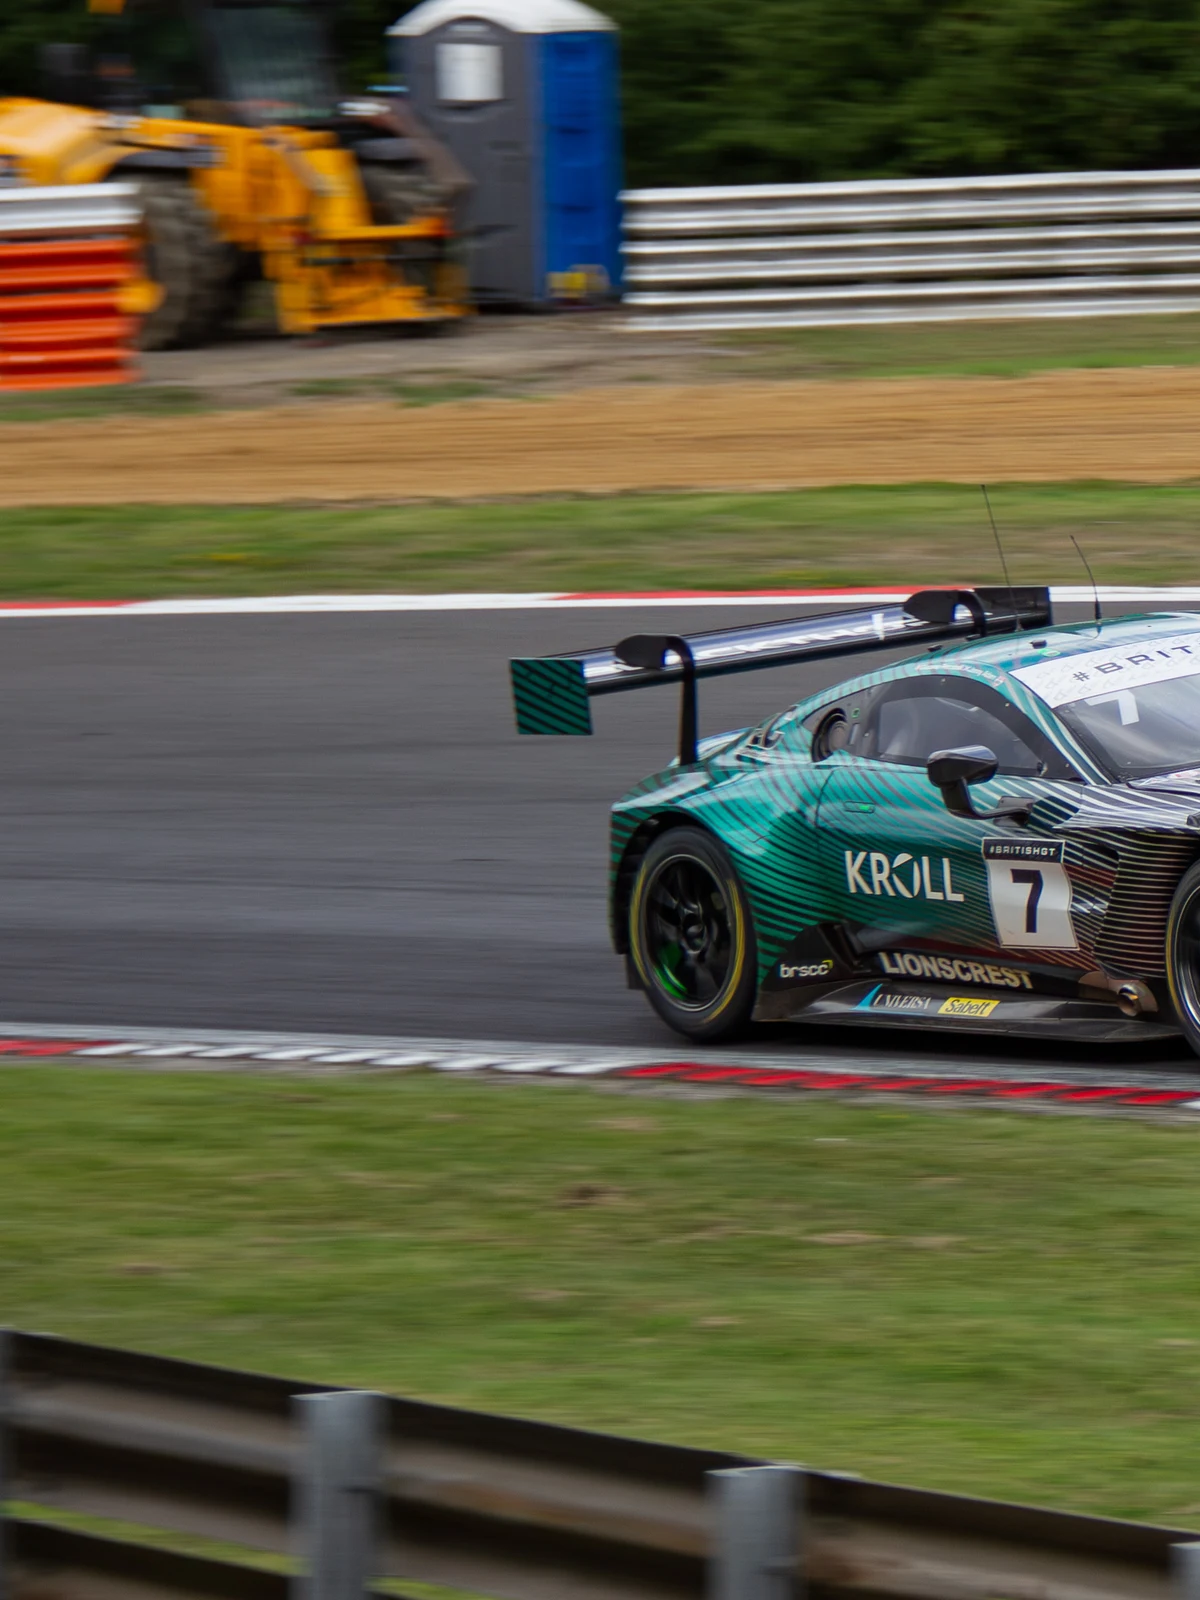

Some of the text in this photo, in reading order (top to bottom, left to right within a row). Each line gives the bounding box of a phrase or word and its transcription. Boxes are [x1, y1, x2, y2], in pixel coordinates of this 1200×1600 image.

[1085, 689, 1139, 725] 7
[990, 845, 1056, 856] #BRITISHGT
[844, 850, 965, 902] KROLL
[1010, 868, 1043, 933] 7
[779, 963, 829, 978] brscc
[878, 951, 1034, 989] LIONSCREST
[945, 999, 990, 1015] Sabelt
